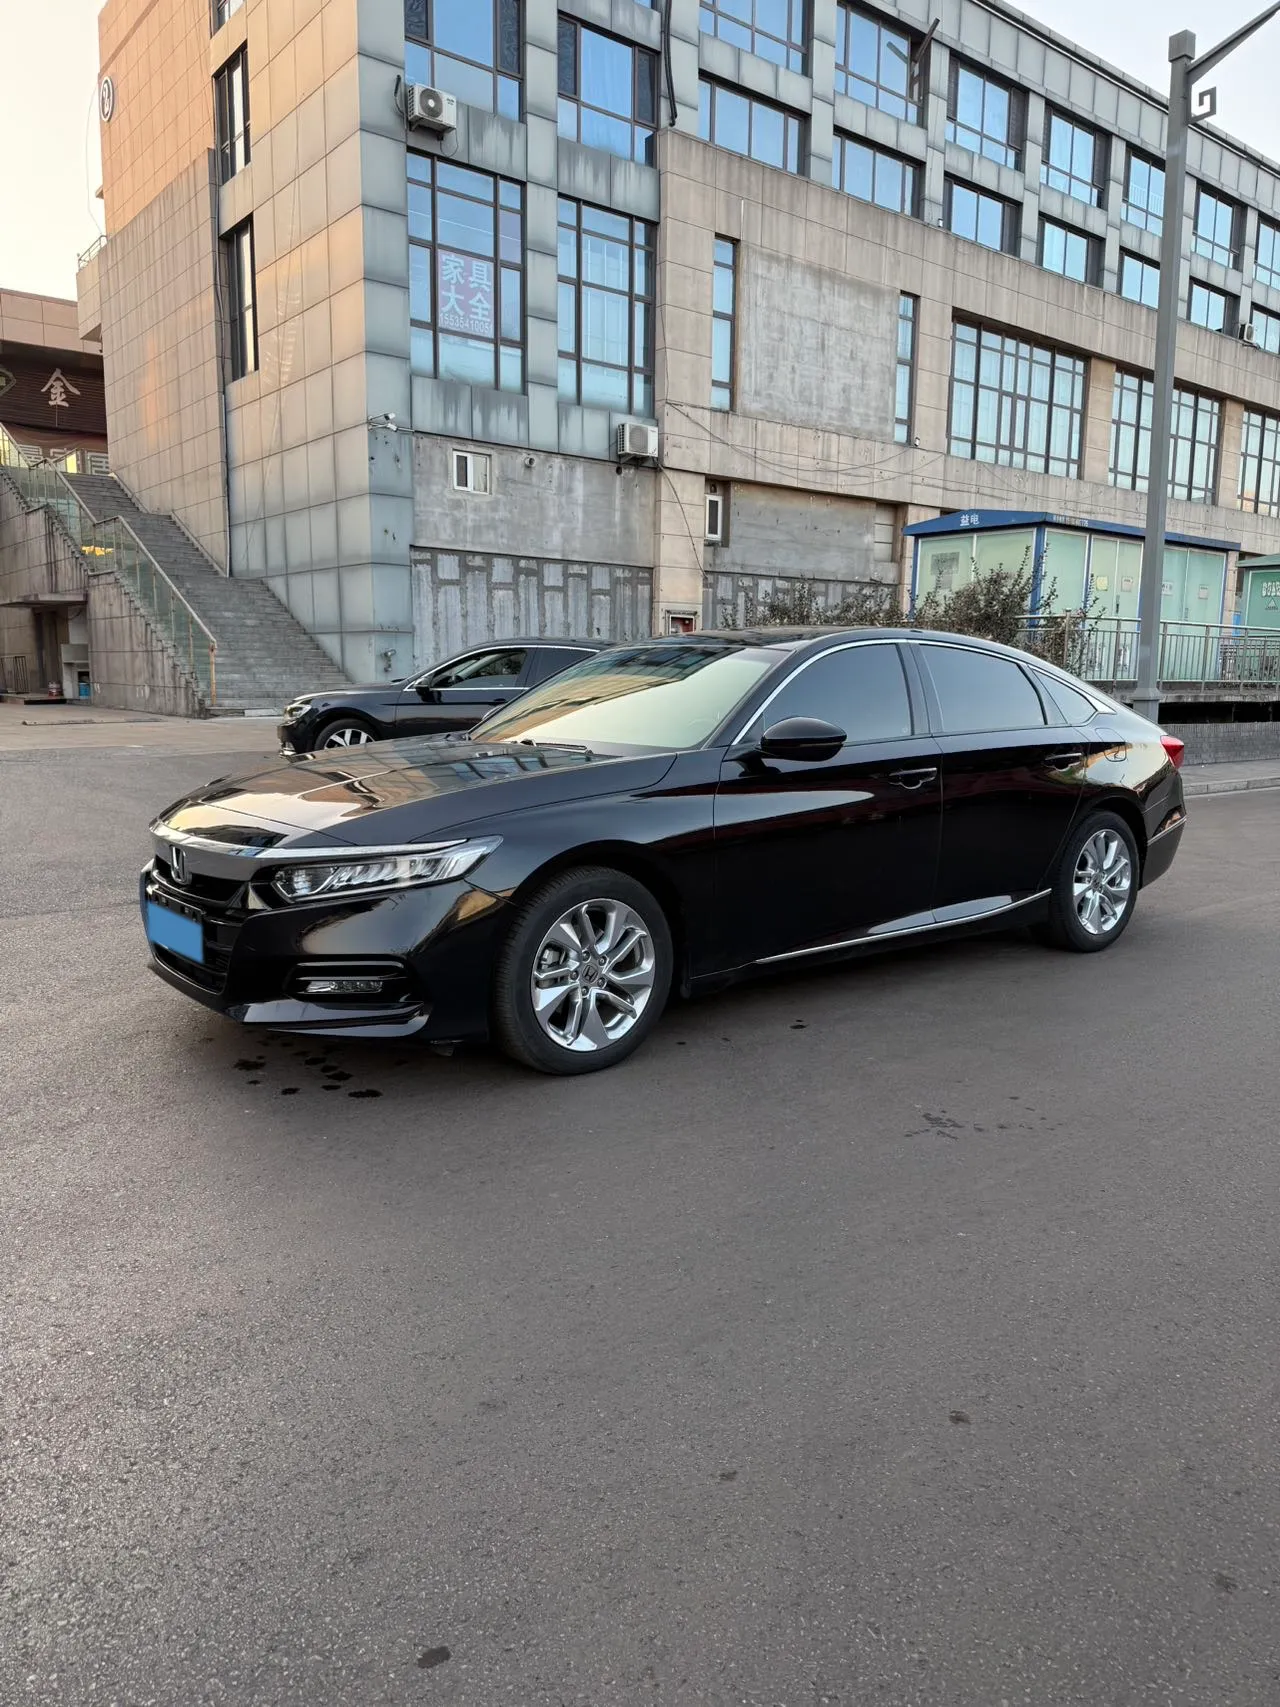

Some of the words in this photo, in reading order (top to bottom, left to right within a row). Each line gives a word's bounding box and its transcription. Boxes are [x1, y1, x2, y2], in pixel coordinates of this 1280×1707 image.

[441, 254, 491, 292] 家具
[441, 285, 491, 322] 大全
[41, 368, 80, 407] 金
